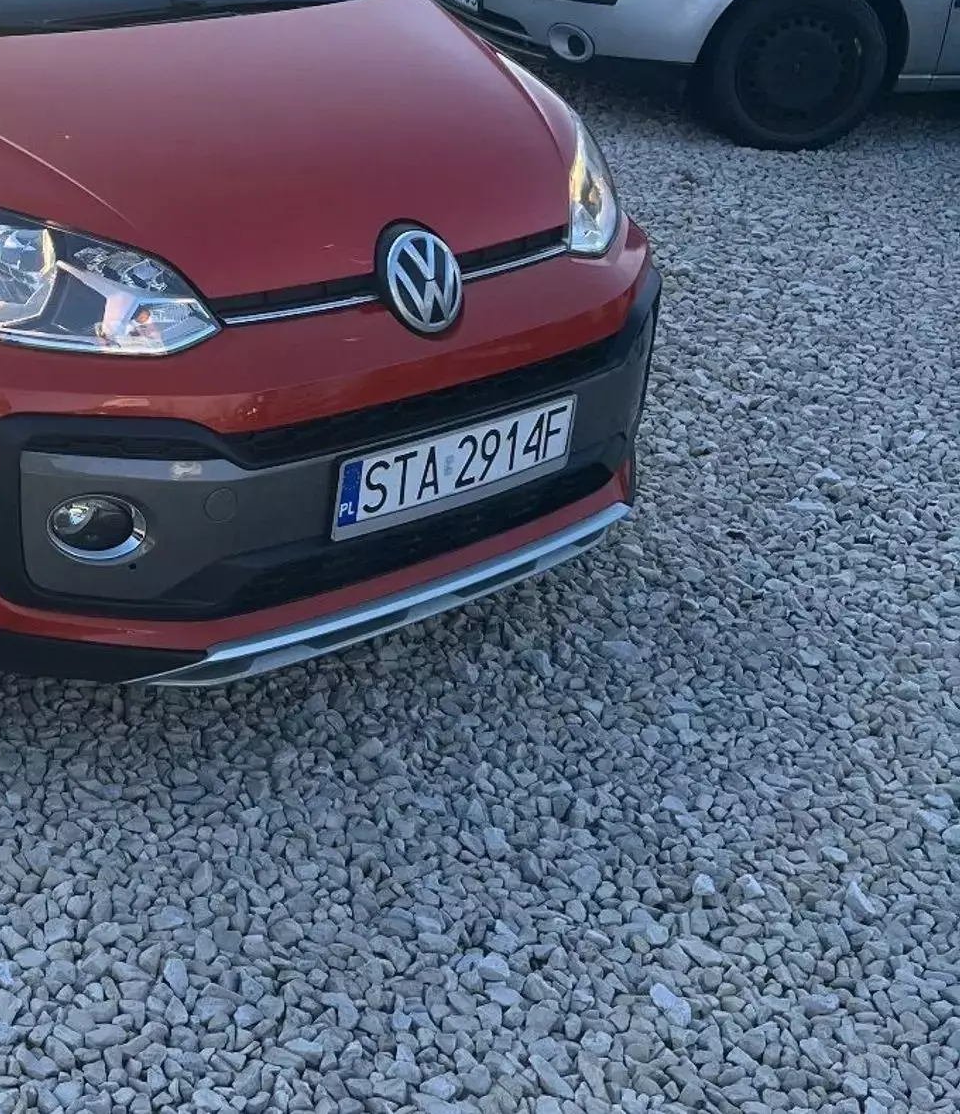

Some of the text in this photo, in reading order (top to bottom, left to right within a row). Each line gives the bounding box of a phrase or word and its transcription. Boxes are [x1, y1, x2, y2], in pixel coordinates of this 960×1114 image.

[362, 405, 568, 514] STA 2914F
[339, 501, 355, 518] PL
